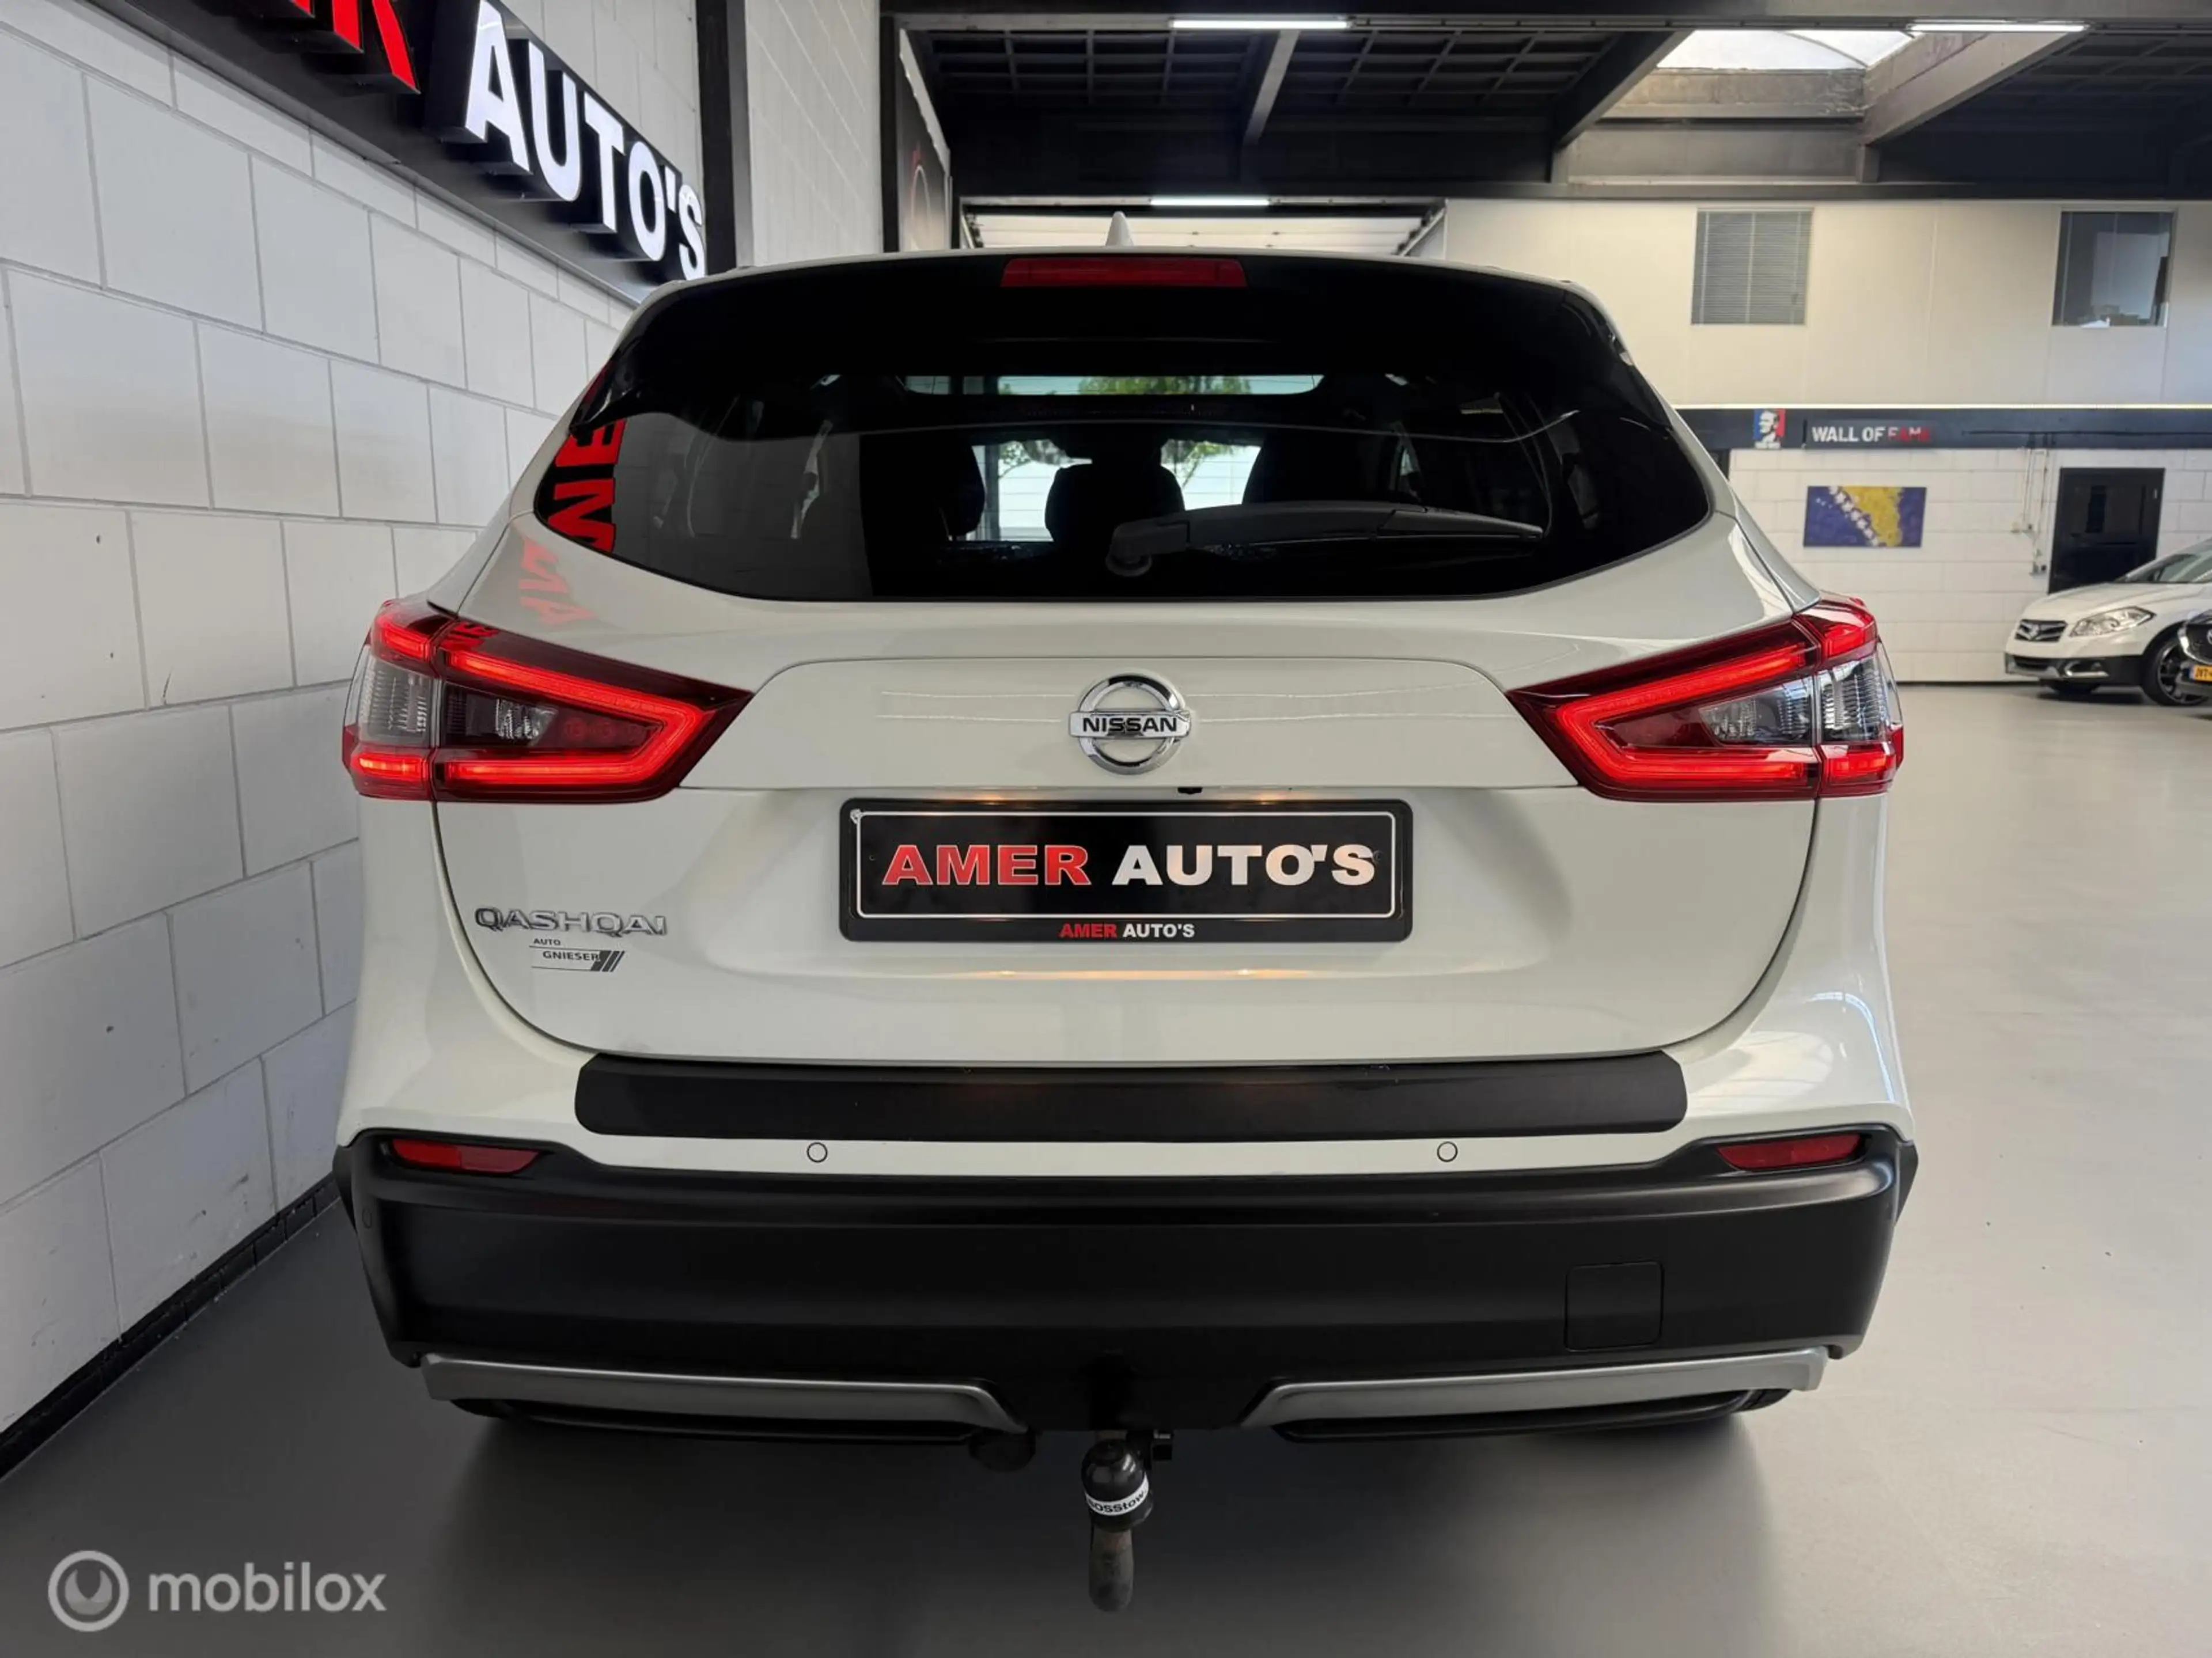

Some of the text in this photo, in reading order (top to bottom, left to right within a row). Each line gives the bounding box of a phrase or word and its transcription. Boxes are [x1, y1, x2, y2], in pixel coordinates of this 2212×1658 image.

[465, 0, 706, 280] AUTO'S
[1812, 426, 1858, 442] WALL
[1862, 426, 1885, 442] OF
[1082, 718, 1177, 732] NISSAN
[882, 844, 1376, 886] AMER AUTO'S
[475, 907, 667, 937] QASHQAI
[1059, 923, 1195, 938] AMER AUTO'S
[543, 950, 600, 961] GNIESER
